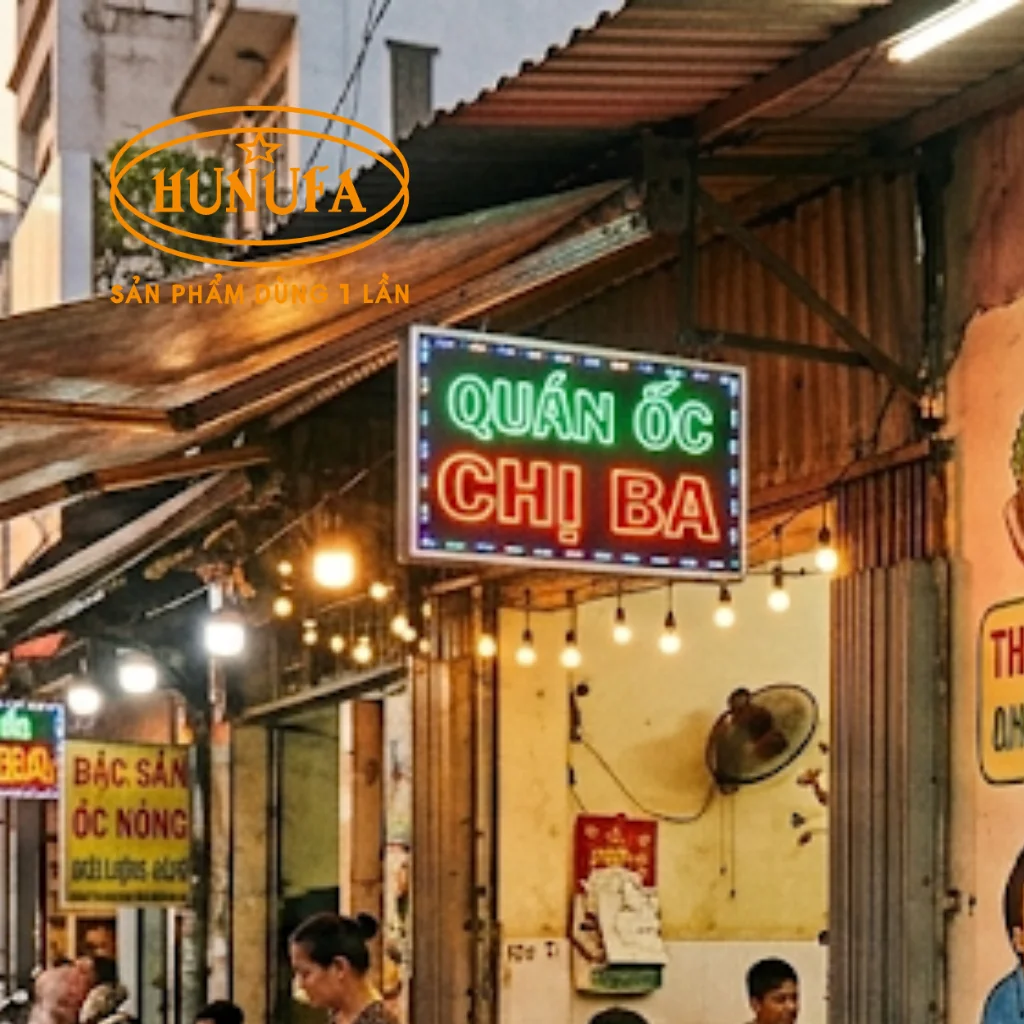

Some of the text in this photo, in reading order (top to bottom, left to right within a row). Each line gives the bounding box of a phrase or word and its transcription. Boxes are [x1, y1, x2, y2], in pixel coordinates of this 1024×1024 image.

[448, 369, 714, 455] QUÁN ỐC
[437, 452, 720, 545] CHỊ BA
